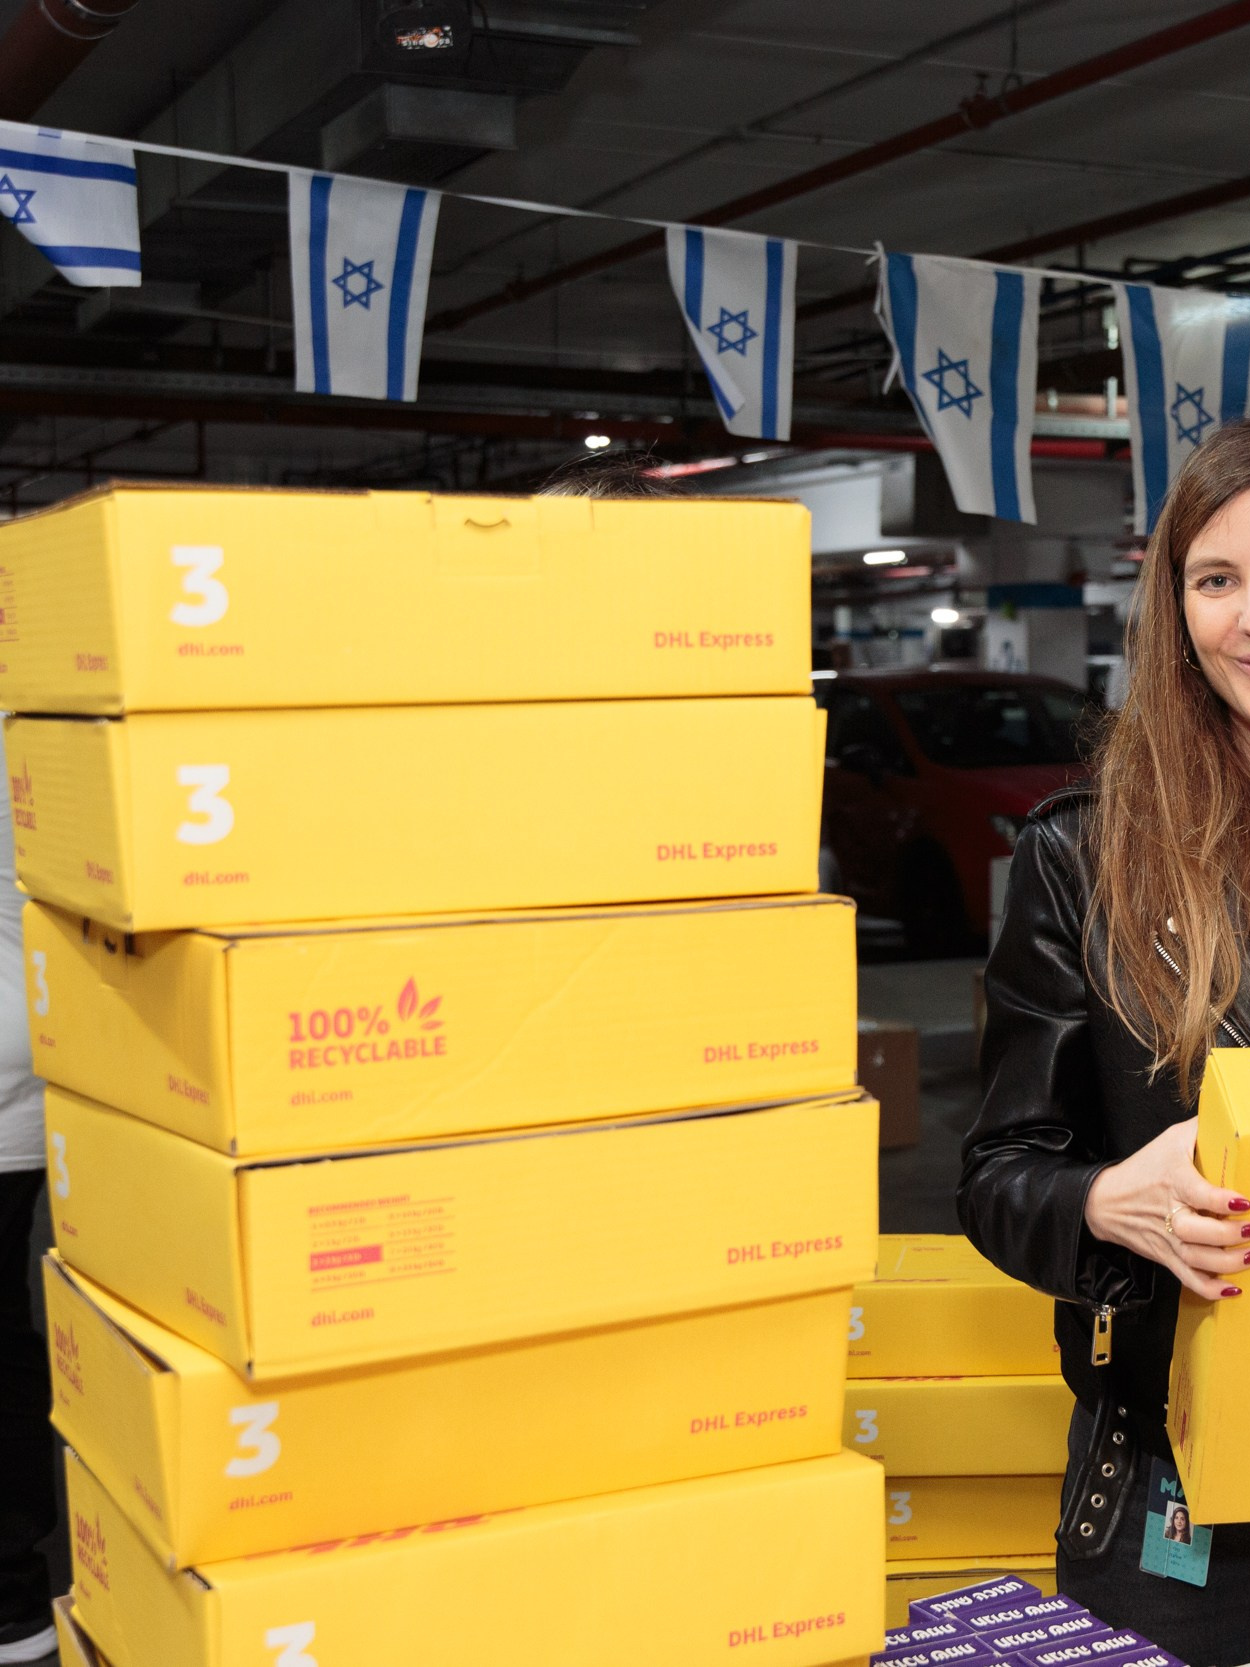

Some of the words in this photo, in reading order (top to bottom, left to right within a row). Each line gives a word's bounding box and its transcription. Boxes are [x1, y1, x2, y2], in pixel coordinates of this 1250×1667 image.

[169, 544, 229, 627] 3
[177, 641, 244, 657] dhl.com
[654, 631, 694, 648] DHL
[699, 631, 774, 651] Express
[175, 763, 234, 845] 3
[657, 843, 697, 861] DHL
[702, 841, 778, 862] Express
[183, 869, 249, 886] dhl.com
[31, 950, 50, 1017] 3
[287, 1006, 390, 1043] 100%
[288, 1034, 447, 1070] RECYCLABLE
[703, 1044, 743, 1065] DHL
[747, 1038, 820, 1061] Express
[291, 1088, 353, 1107] dhl.com
[51, 1130, 71, 1199] 3
[727, 1243, 766, 1265] DHL
[771, 1235, 843, 1260] Express
[311, 1307, 374, 1327] dhl.com
[847, 1306, 865, 1341] 3
[690, 1413, 729, 1435] DHL
[734, 1404, 808, 1427] Express
[854, 1409, 879, 1443] 3
[225, 1401, 281, 1478] 3
[229, 1490, 294, 1511] dhl.com
[888, 1491, 912, 1525] 3
[972, 1581, 1023, 1602] חנוכה
[970, 1608, 1024, 1627] חנוכה
[1024, 1599, 1069, 1617] שמח
[728, 1626, 768, 1648] DHL
[772, 1611, 846, 1637] Express
[912, 1623, 957, 1641] שמח
[993, 1628, 1048, 1649] חנוכה
[1048, 1617, 1093, 1637] שמח
[930, 1643, 976, 1662] שמח
[1035, 1645, 1092, 1665] חנוכה
[1092, 1634, 1137, 1653] שמח
